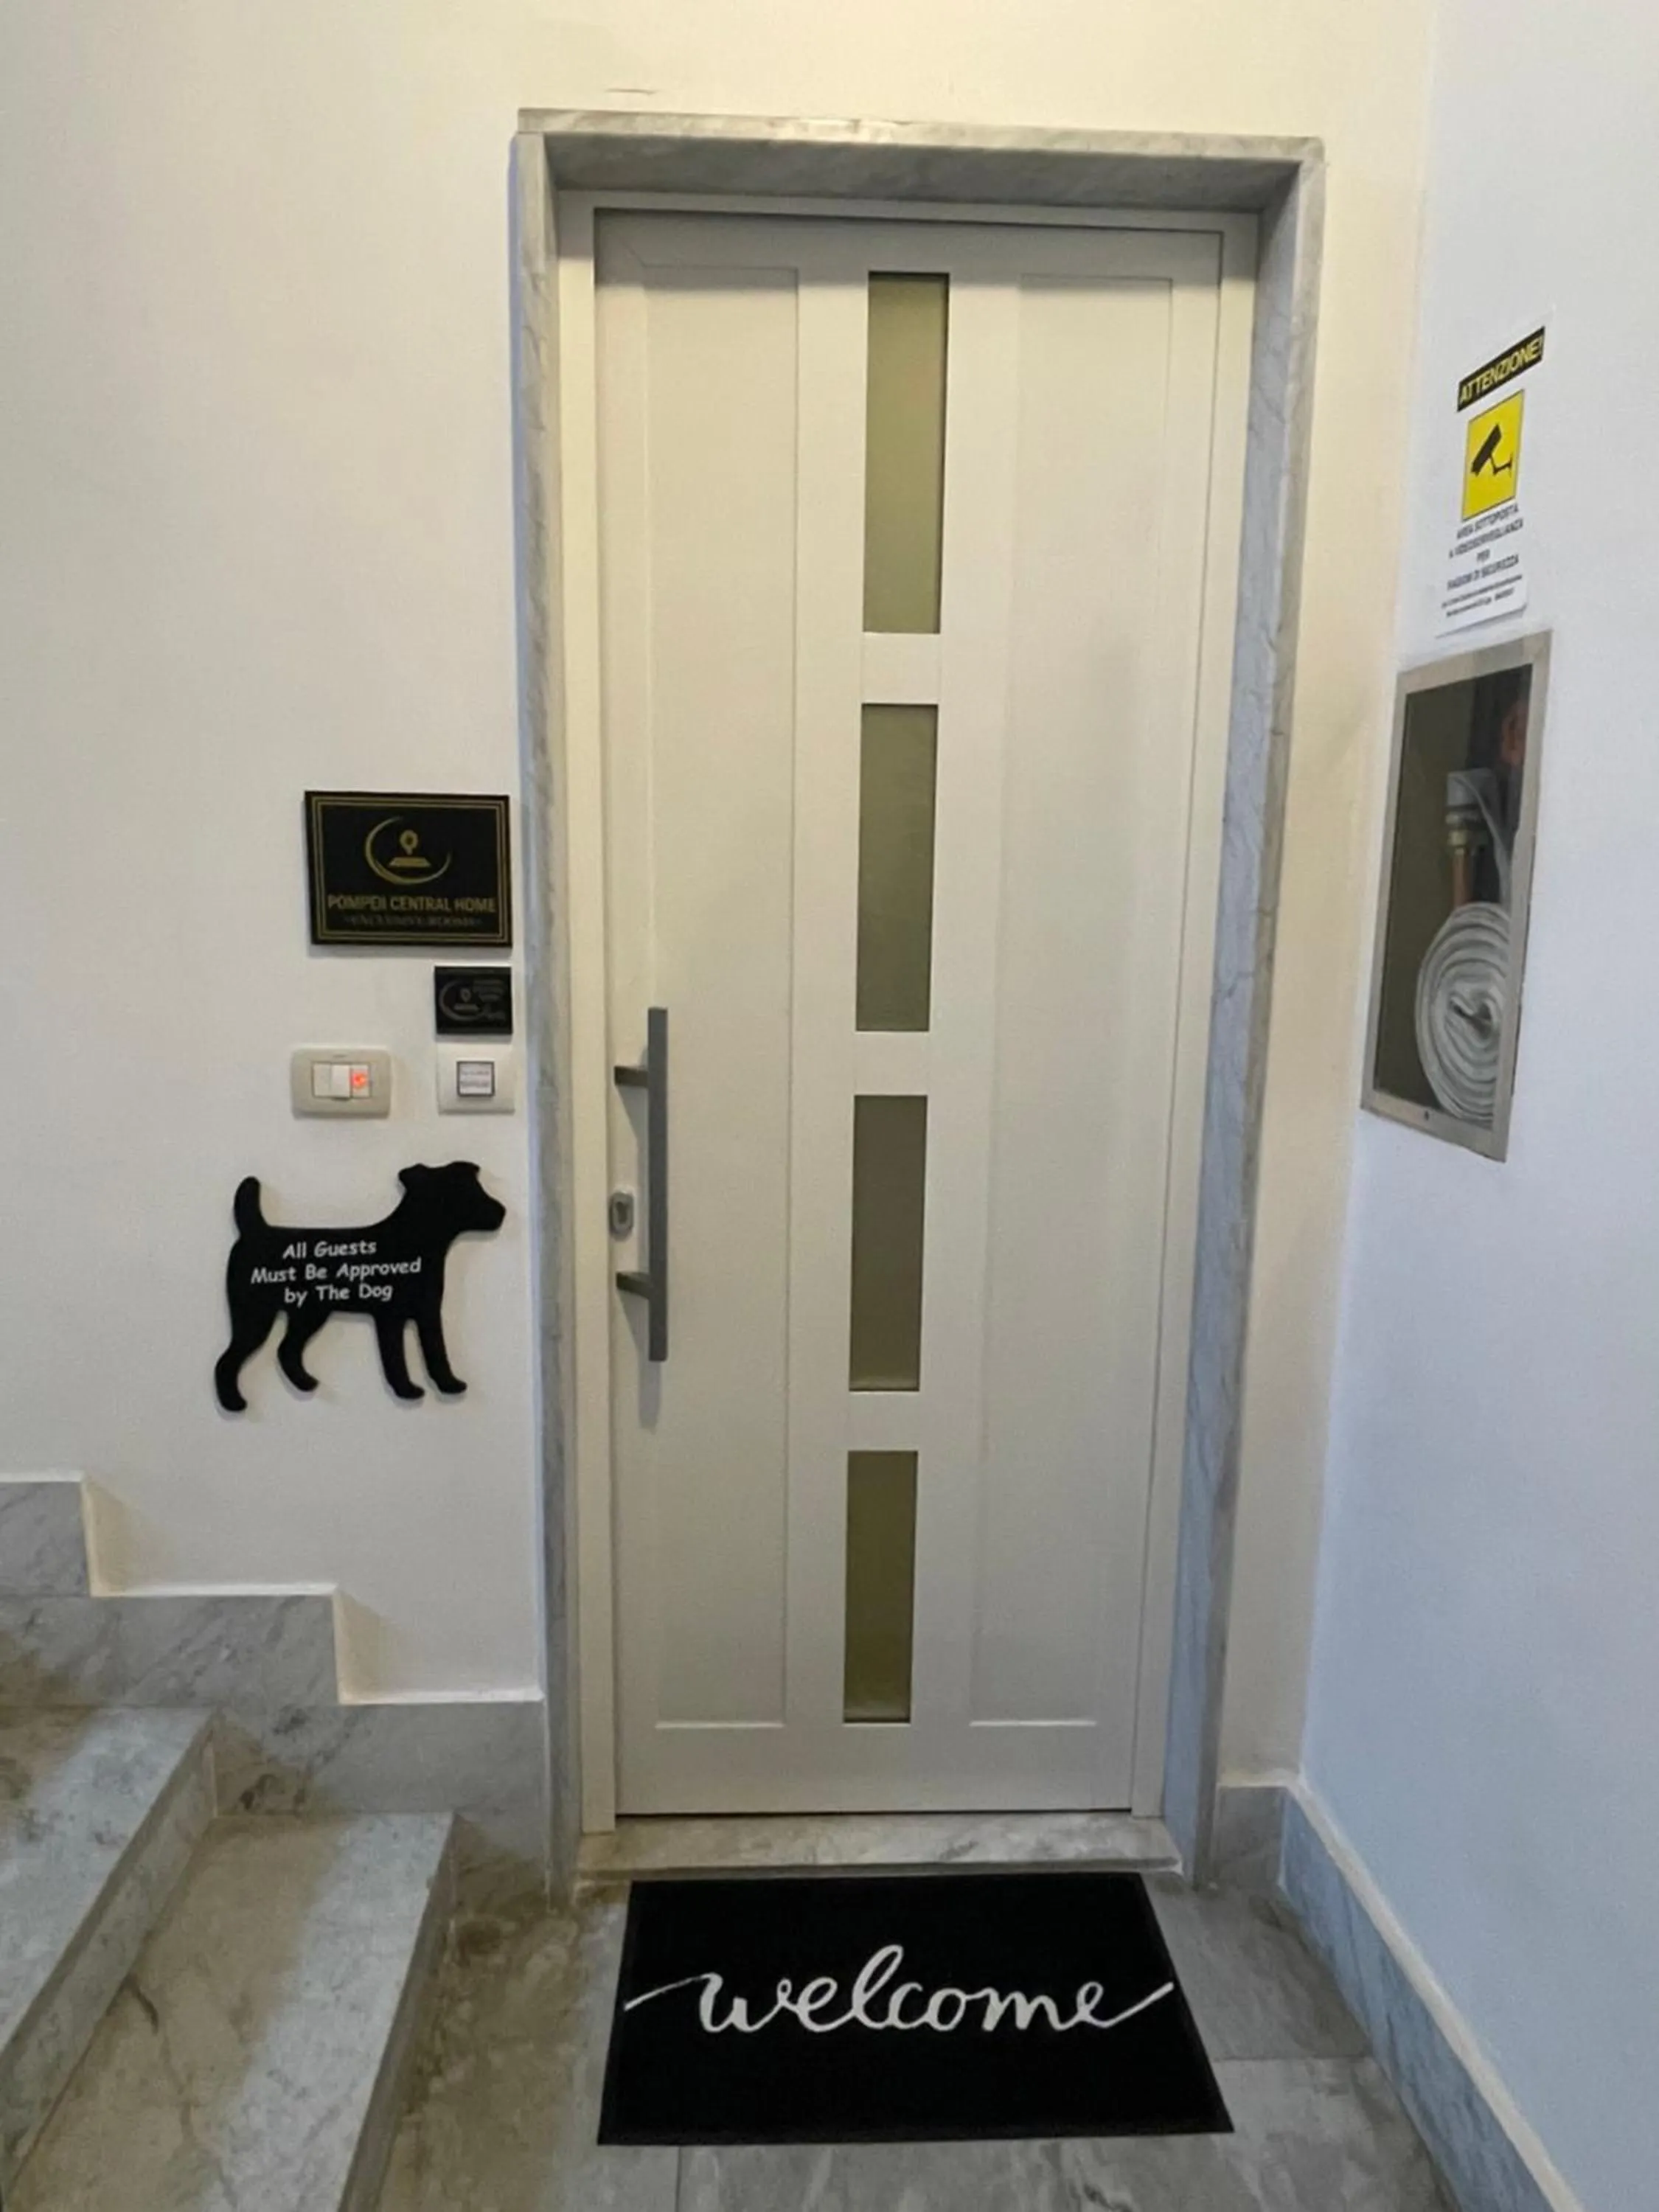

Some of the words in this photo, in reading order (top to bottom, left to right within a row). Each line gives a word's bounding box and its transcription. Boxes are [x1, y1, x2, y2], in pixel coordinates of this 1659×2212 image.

[327, 894, 387, 911] POMPEI
[390, 896, 451, 911] CENTRAL
[454, 897, 495, 912] HOME
[282, 1242, 307, 1259] All
[314, 1240, 377, 1257] Guests
[251, 1267, 296, 1284] Must
[305, 1263, 327, 1280] Be
[335, 1256, 422, 1281] Approved
[284, 1288, 307, 1308] by
[316, 1284, 349, 1301] The
[359, 1283, 393, 1302] Dog
[625, 1944, 1174, 2032] welcome
